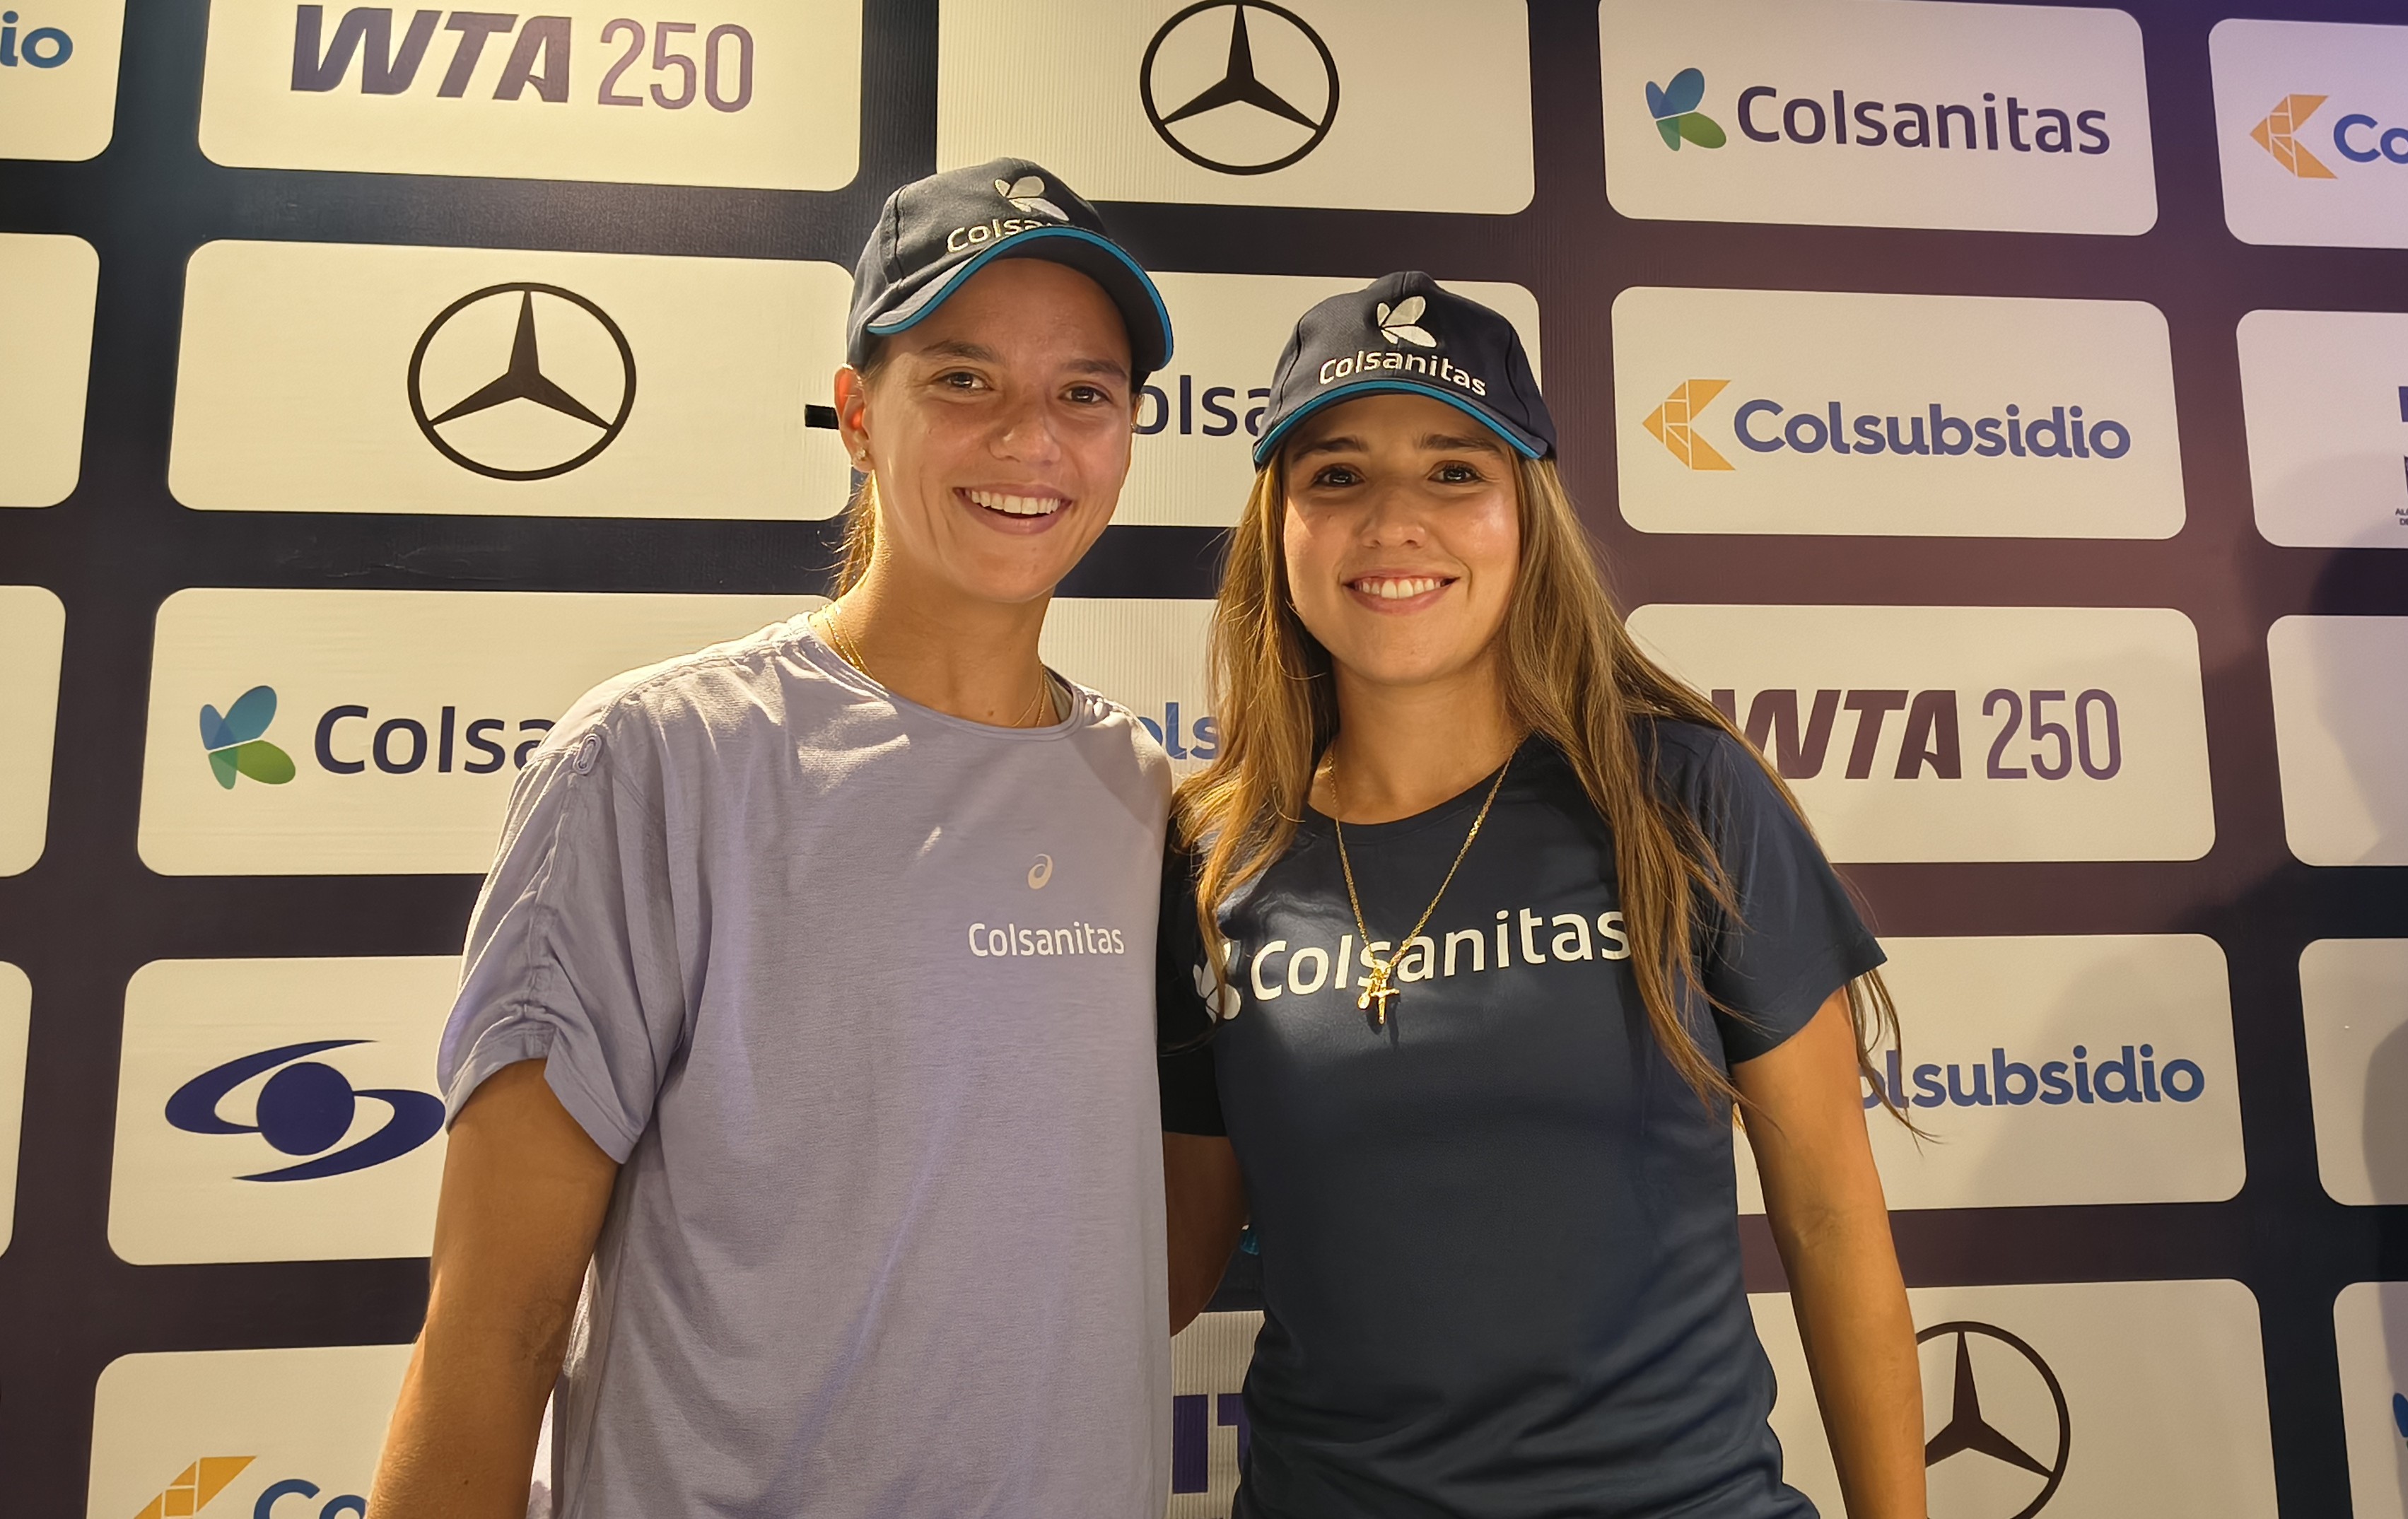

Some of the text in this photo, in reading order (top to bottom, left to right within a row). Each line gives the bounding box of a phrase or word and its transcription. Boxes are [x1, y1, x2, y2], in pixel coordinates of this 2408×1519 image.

[291, 4, 754, 113] WTA 250
[1736, 85, 2110, 155] Colsanitas
[1319, 350, 1486, 396] Colsanitas
[1734, 398, 2132, 459] Colsubsidio
[1711, 688, 2122, 780] WTA 250
[968, 920, 1125, 957] Colsanitas
[1250, 907, 1633, 1001] Colsanitas
